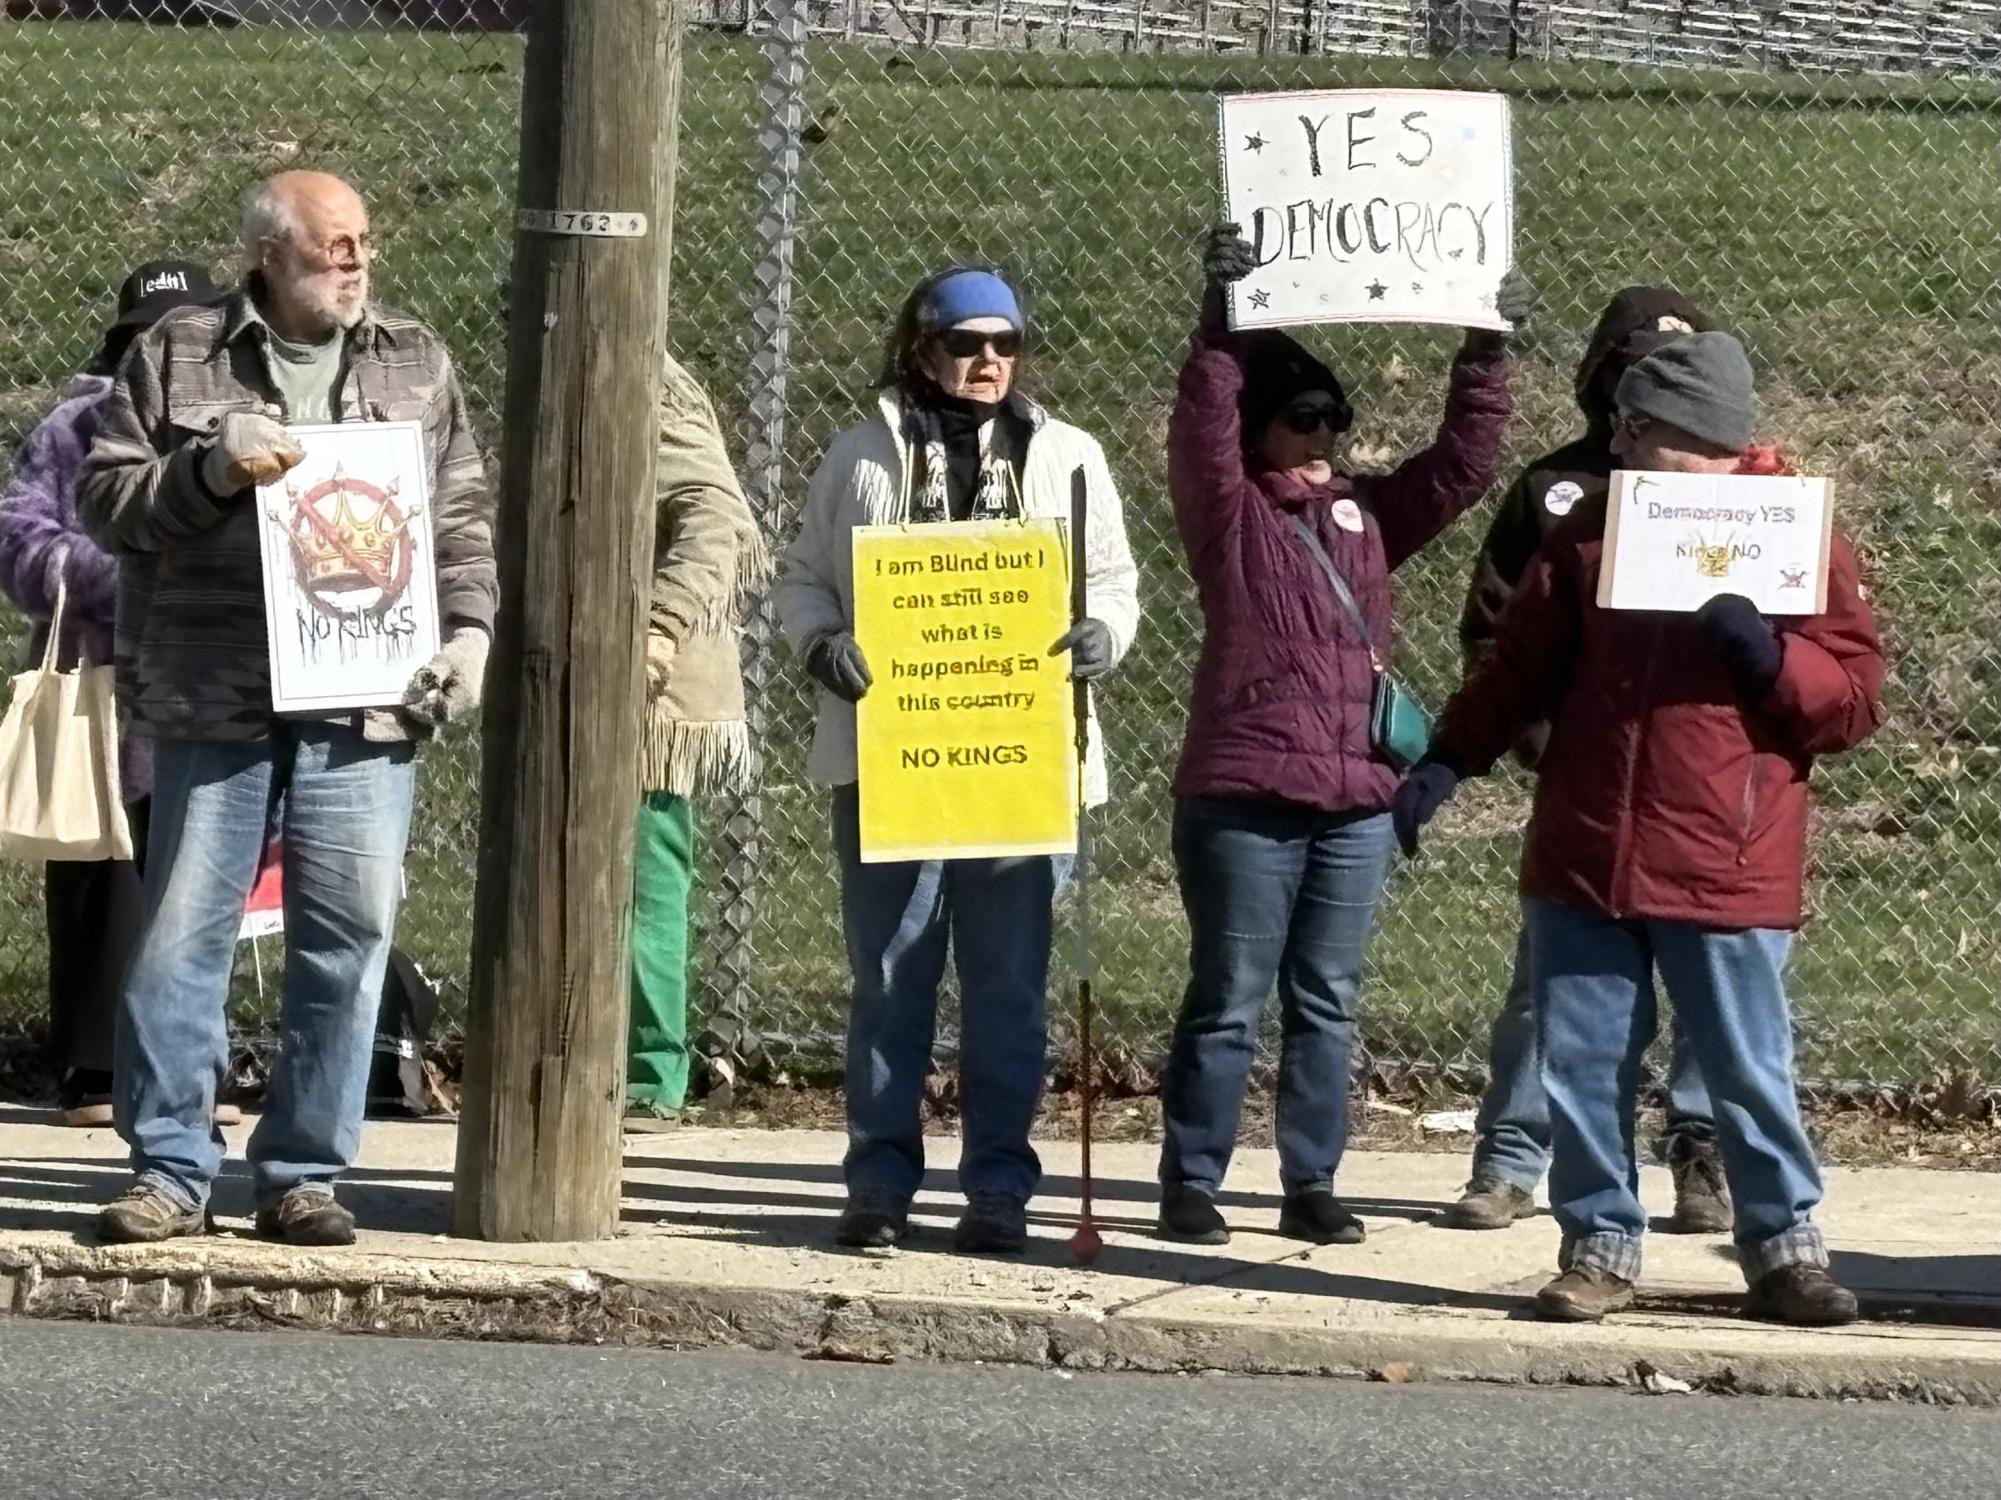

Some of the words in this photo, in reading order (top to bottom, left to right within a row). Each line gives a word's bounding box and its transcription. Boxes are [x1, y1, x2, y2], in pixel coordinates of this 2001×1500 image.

[1298, 106, 1433, 177] YES
[1252, 197, 1495, 272] DEMOCRACY
[1760, 505, 1796, 523] YES
[875, 559, 882, 576] I
[888, 561, 924, 575] am
[930, 552, 989, 573] Blind
[994, 550, 1033, 570] but
[1038, 549, 1044, 567] I
[1731, 543, 1761, 560] NO
[892, 593, 935, 609] can
[940, 587, 982, 607] still
[988, 590, 1029, 605] see
[296, 605, 331, 649] NO
[338, 604, 418, 649] KINGS
[921, 623, 978, 644] what
[983, 623, 1003, 640] is
[891, 654, 1014, 680] happening
[1017, 653, 1039, 671] in
[896, 693, 941, 712] this
[946, 691, 1036, 711] country
[900, 748, 941, 769] NO
[946, 744, 1029, 768] KINGS
